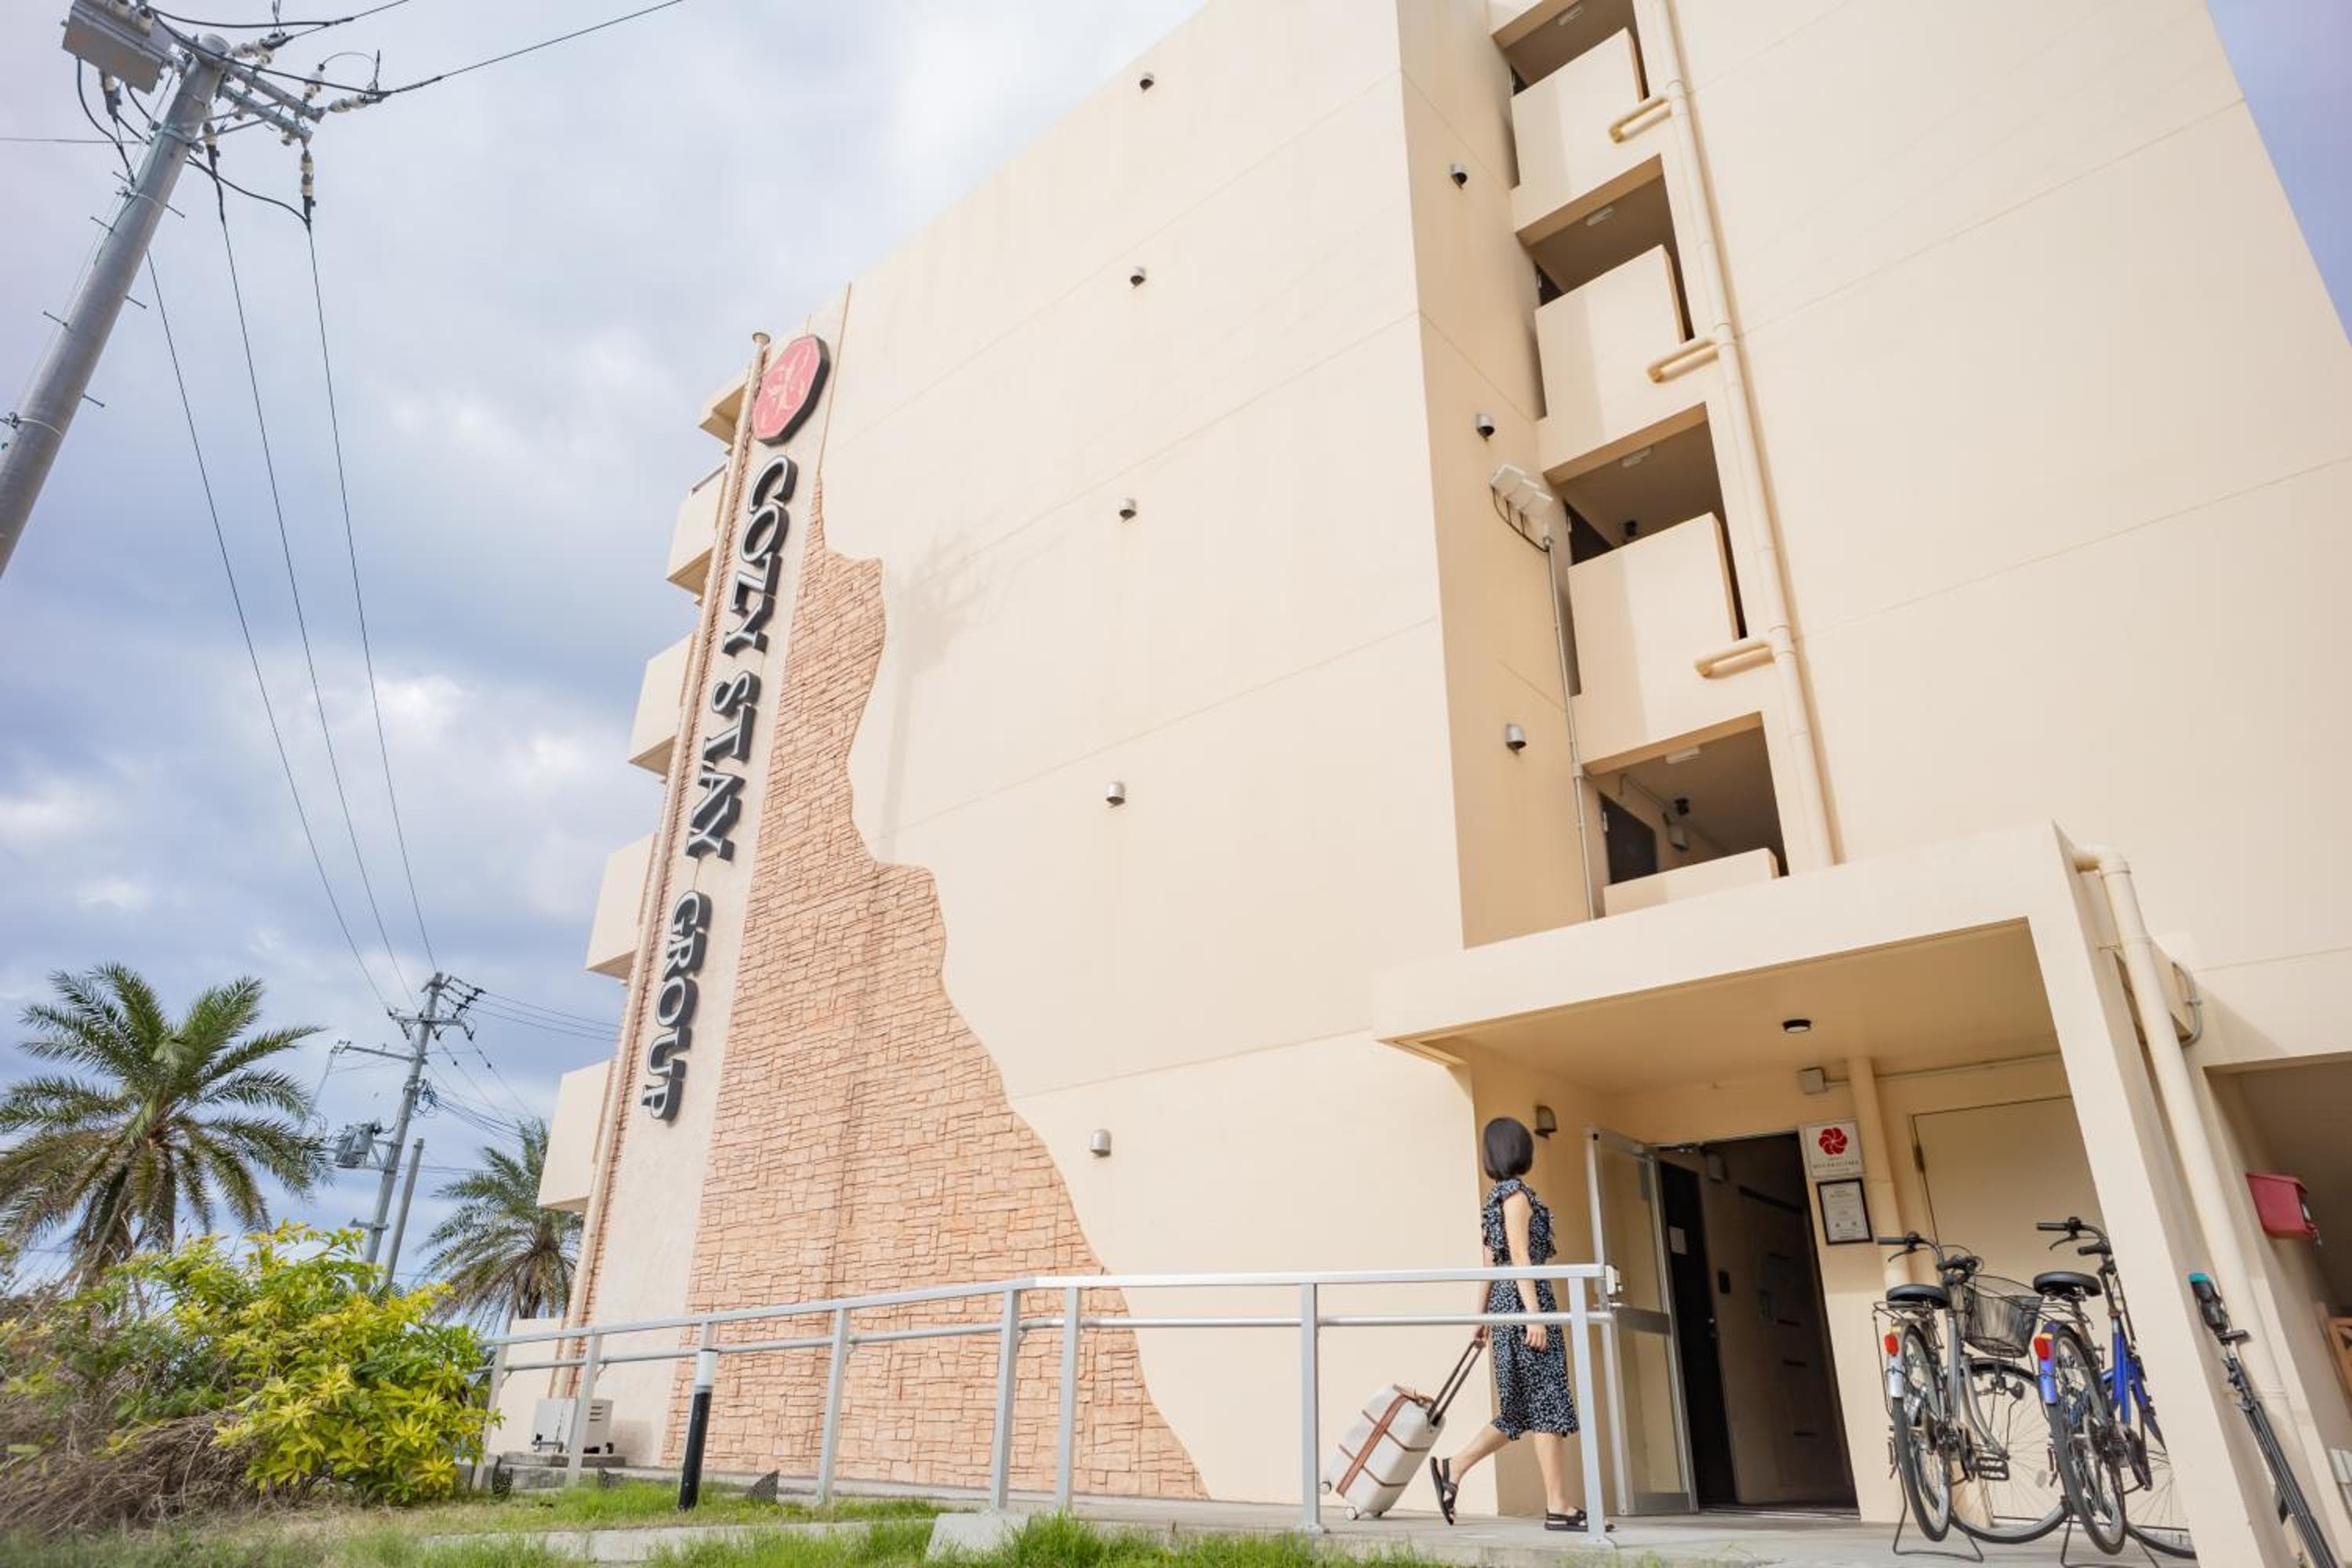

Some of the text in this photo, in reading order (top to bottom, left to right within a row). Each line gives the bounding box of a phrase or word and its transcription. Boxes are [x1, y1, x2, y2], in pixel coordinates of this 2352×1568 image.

[641, 455, 797, 1121] COZY STAY GROUP
